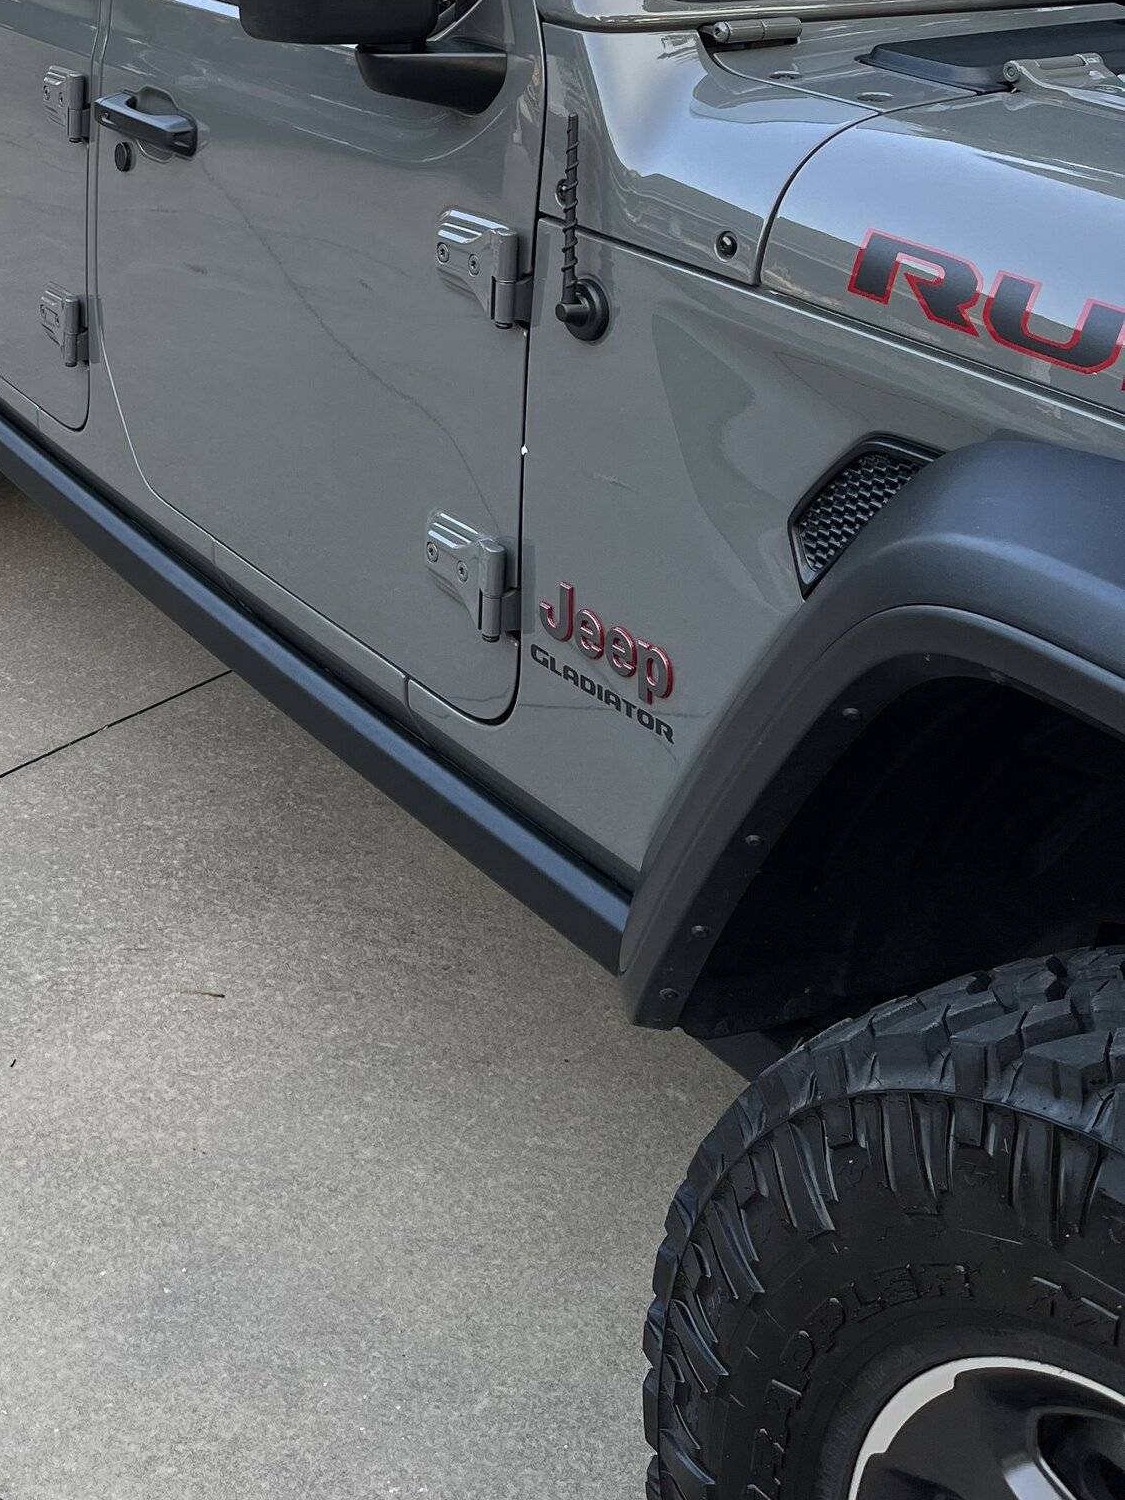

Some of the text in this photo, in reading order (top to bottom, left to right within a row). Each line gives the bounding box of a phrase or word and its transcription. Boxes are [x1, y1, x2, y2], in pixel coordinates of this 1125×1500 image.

[847, 227, 1125, 392] RU
[530, 643, 675, 745] GLADIATOR
[538, 580, 674, 705] Jeep
